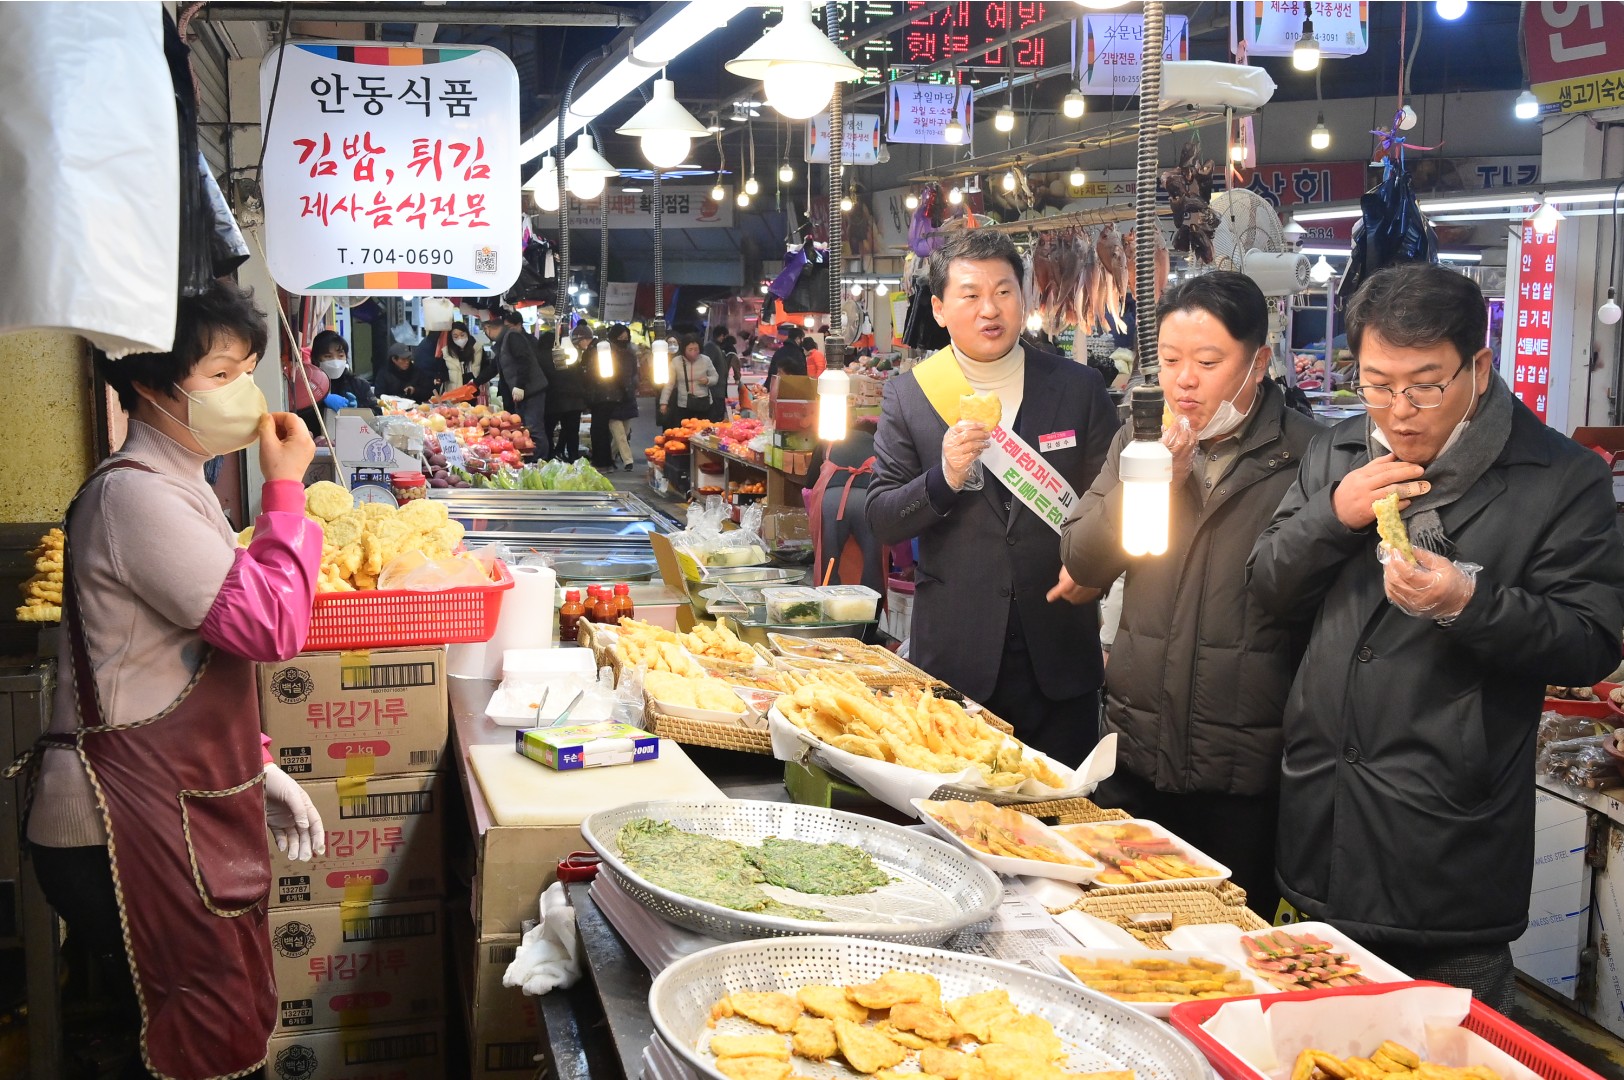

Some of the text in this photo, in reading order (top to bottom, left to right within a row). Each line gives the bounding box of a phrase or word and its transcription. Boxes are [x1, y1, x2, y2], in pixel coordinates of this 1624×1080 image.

[1270, 1, 1352, 18] 제수용 각종생선
[310, 73, 478, 118] 안동식품
[912, 92, 954, 104] 과일마당
[910, 106, 926, 116] 과일
[293, 131, 491, 184] 김밥, 튀김
[299, 191, 491, 229] 제사음식전문
[337, 248, 453, 265] T. 704-0690
[1517, 337, 1549, 355] 선물세트
[282, 682, 302, 694] 백설
[306, 698, 408, 729] 튀김가루
[283, 756, 309, 764] 132787
[563, 754, 577, 764] 두손
[282, 886, 308, 894] 132787
[284, 1009, 310, 1017] 132787
